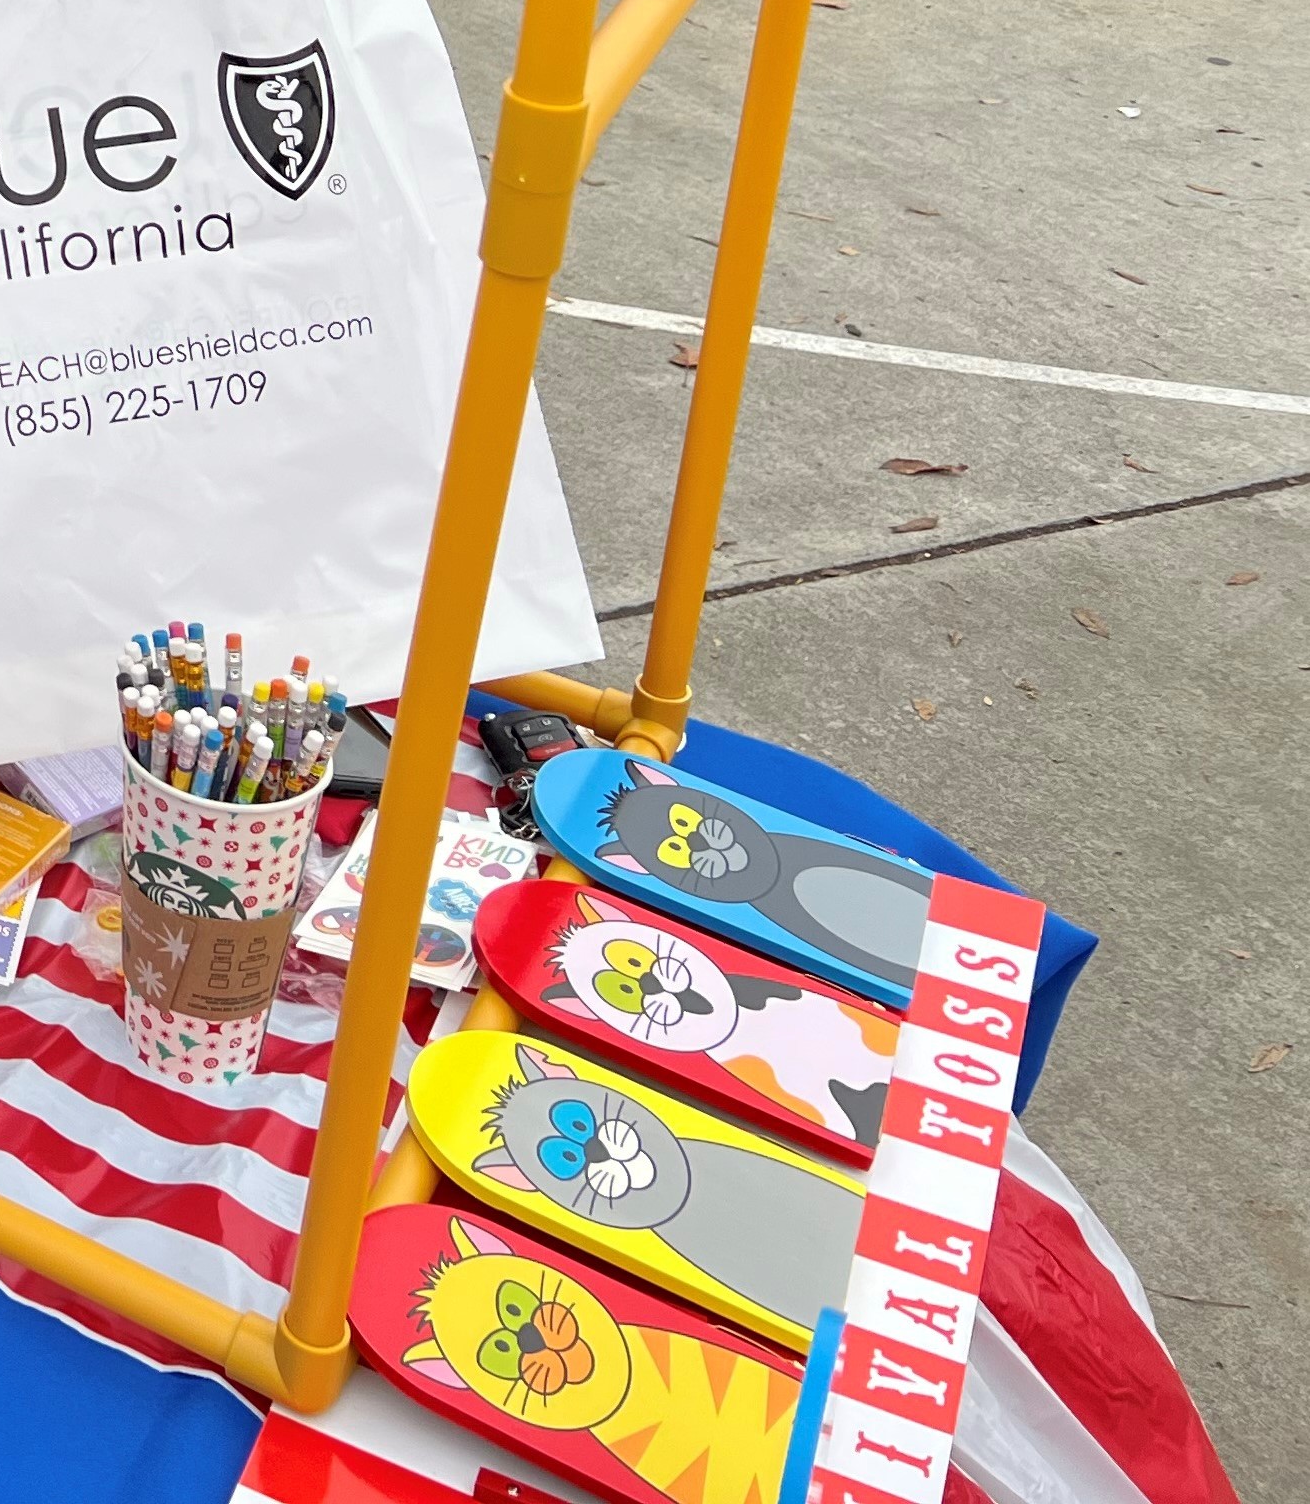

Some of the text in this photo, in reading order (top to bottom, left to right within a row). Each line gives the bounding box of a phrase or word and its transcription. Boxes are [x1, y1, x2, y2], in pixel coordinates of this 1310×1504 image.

[4, 369, 268, 447] (855) 225-1709
[843, 943, 1021, 1504] IVAL TOSS
